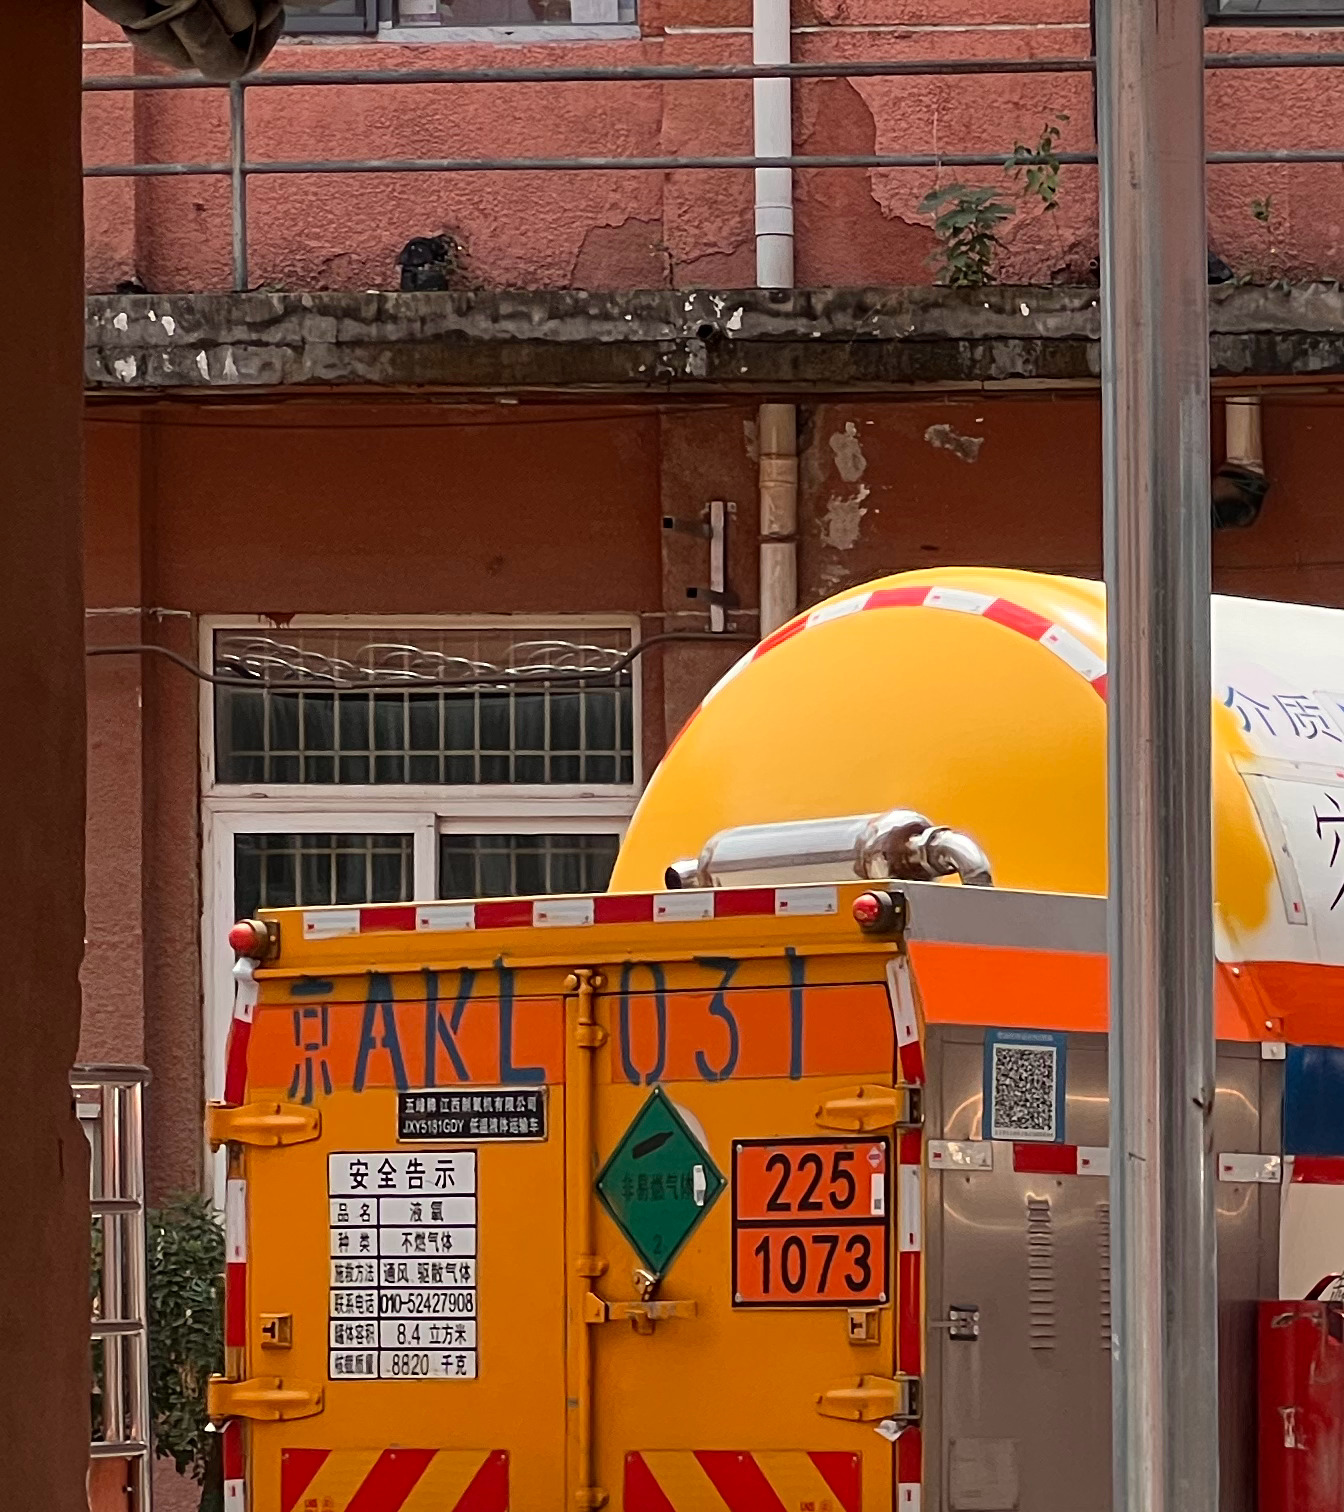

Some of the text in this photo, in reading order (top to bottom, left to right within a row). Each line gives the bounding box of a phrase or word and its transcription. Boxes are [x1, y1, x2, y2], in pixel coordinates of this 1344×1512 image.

[1224, 686, 1342, 742] 介质
[349, 1157, 455, 1190] 安全告示
[765, 1151, 857, 1212] 225
[337, 1202, 371, 1223] 品名
[401, 1232, 453, 1254] 不燃气体
[754, 1234, 872, 1294] 1073
[380, 1293, 474, 1314] 010-52427908
[397, 1323, 421, 1345] 8.4
[429, 1323, 467, 1345] 立方米
[391, 1353, 430, 1376] 8820
[441, 1354, 467, 1376] 千克
